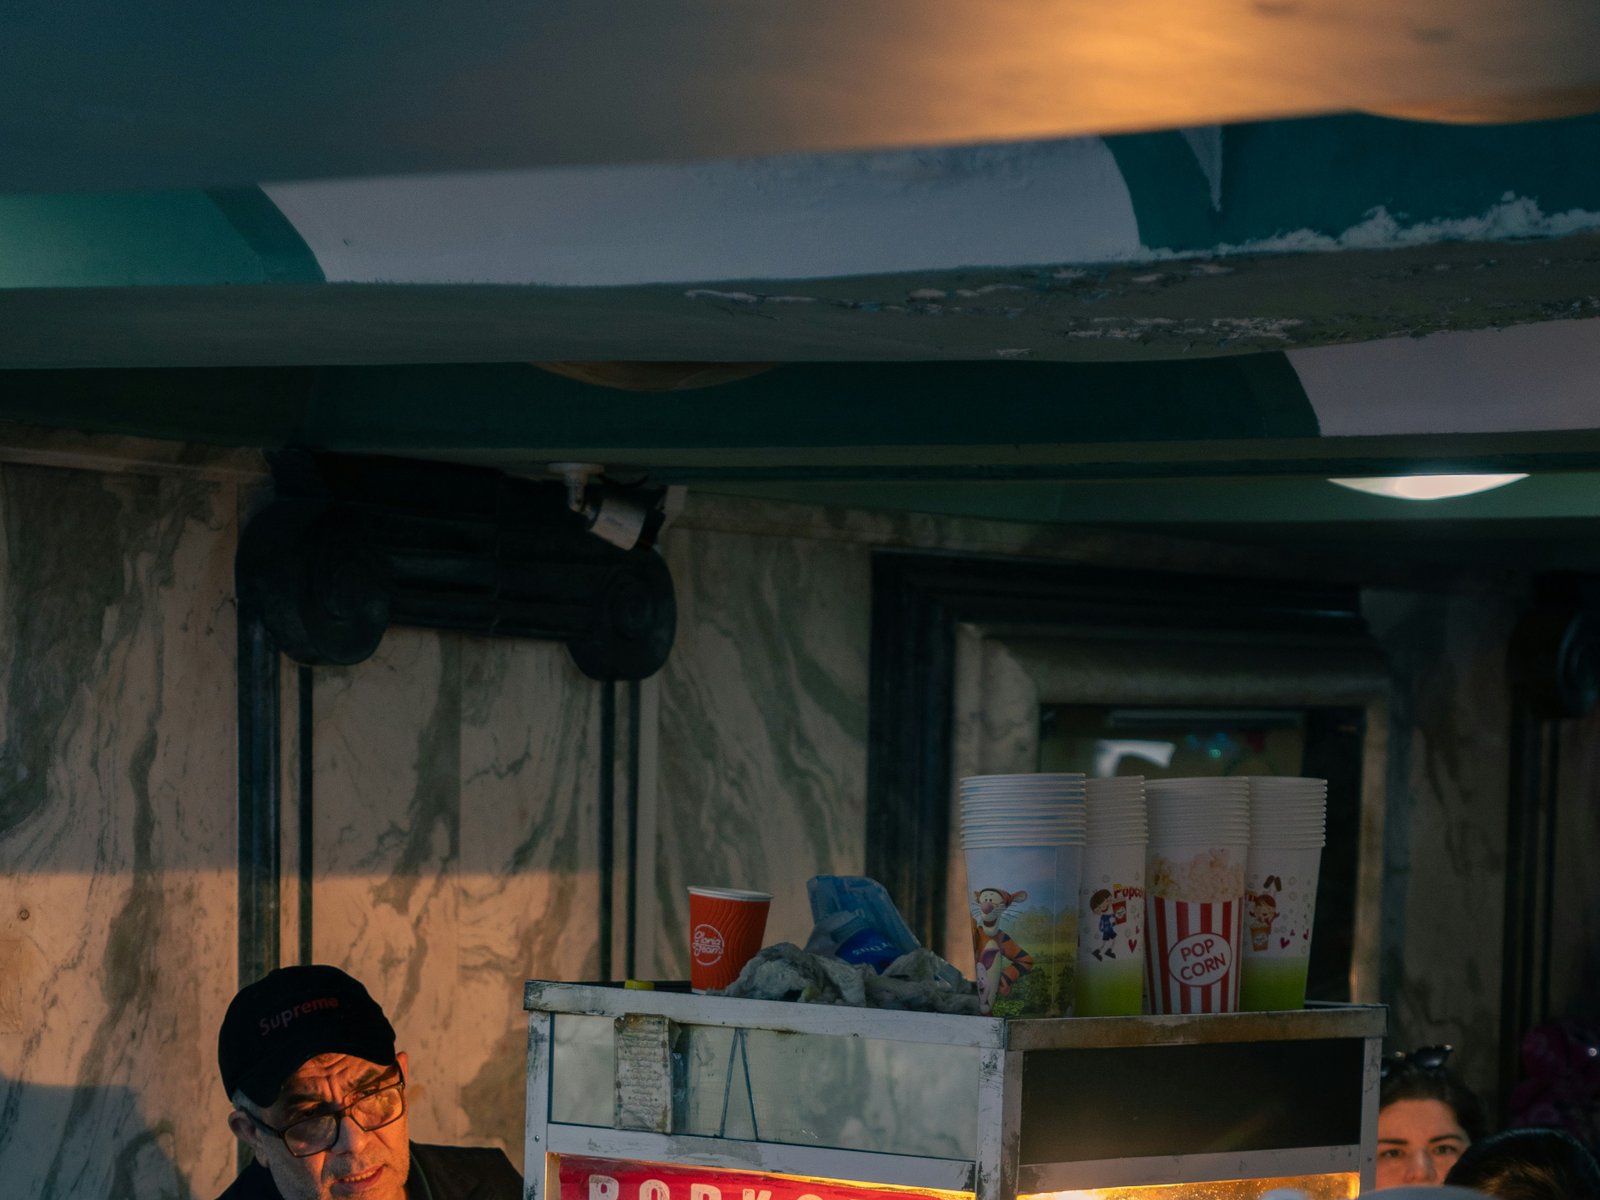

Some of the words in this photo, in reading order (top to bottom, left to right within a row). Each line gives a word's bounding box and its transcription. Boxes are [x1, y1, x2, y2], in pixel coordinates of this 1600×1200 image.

[1180, 938, 1214, 962] POP
[1180, 952, 1226, 980] CORN
[258, 996, 339, 1037] Supreme
